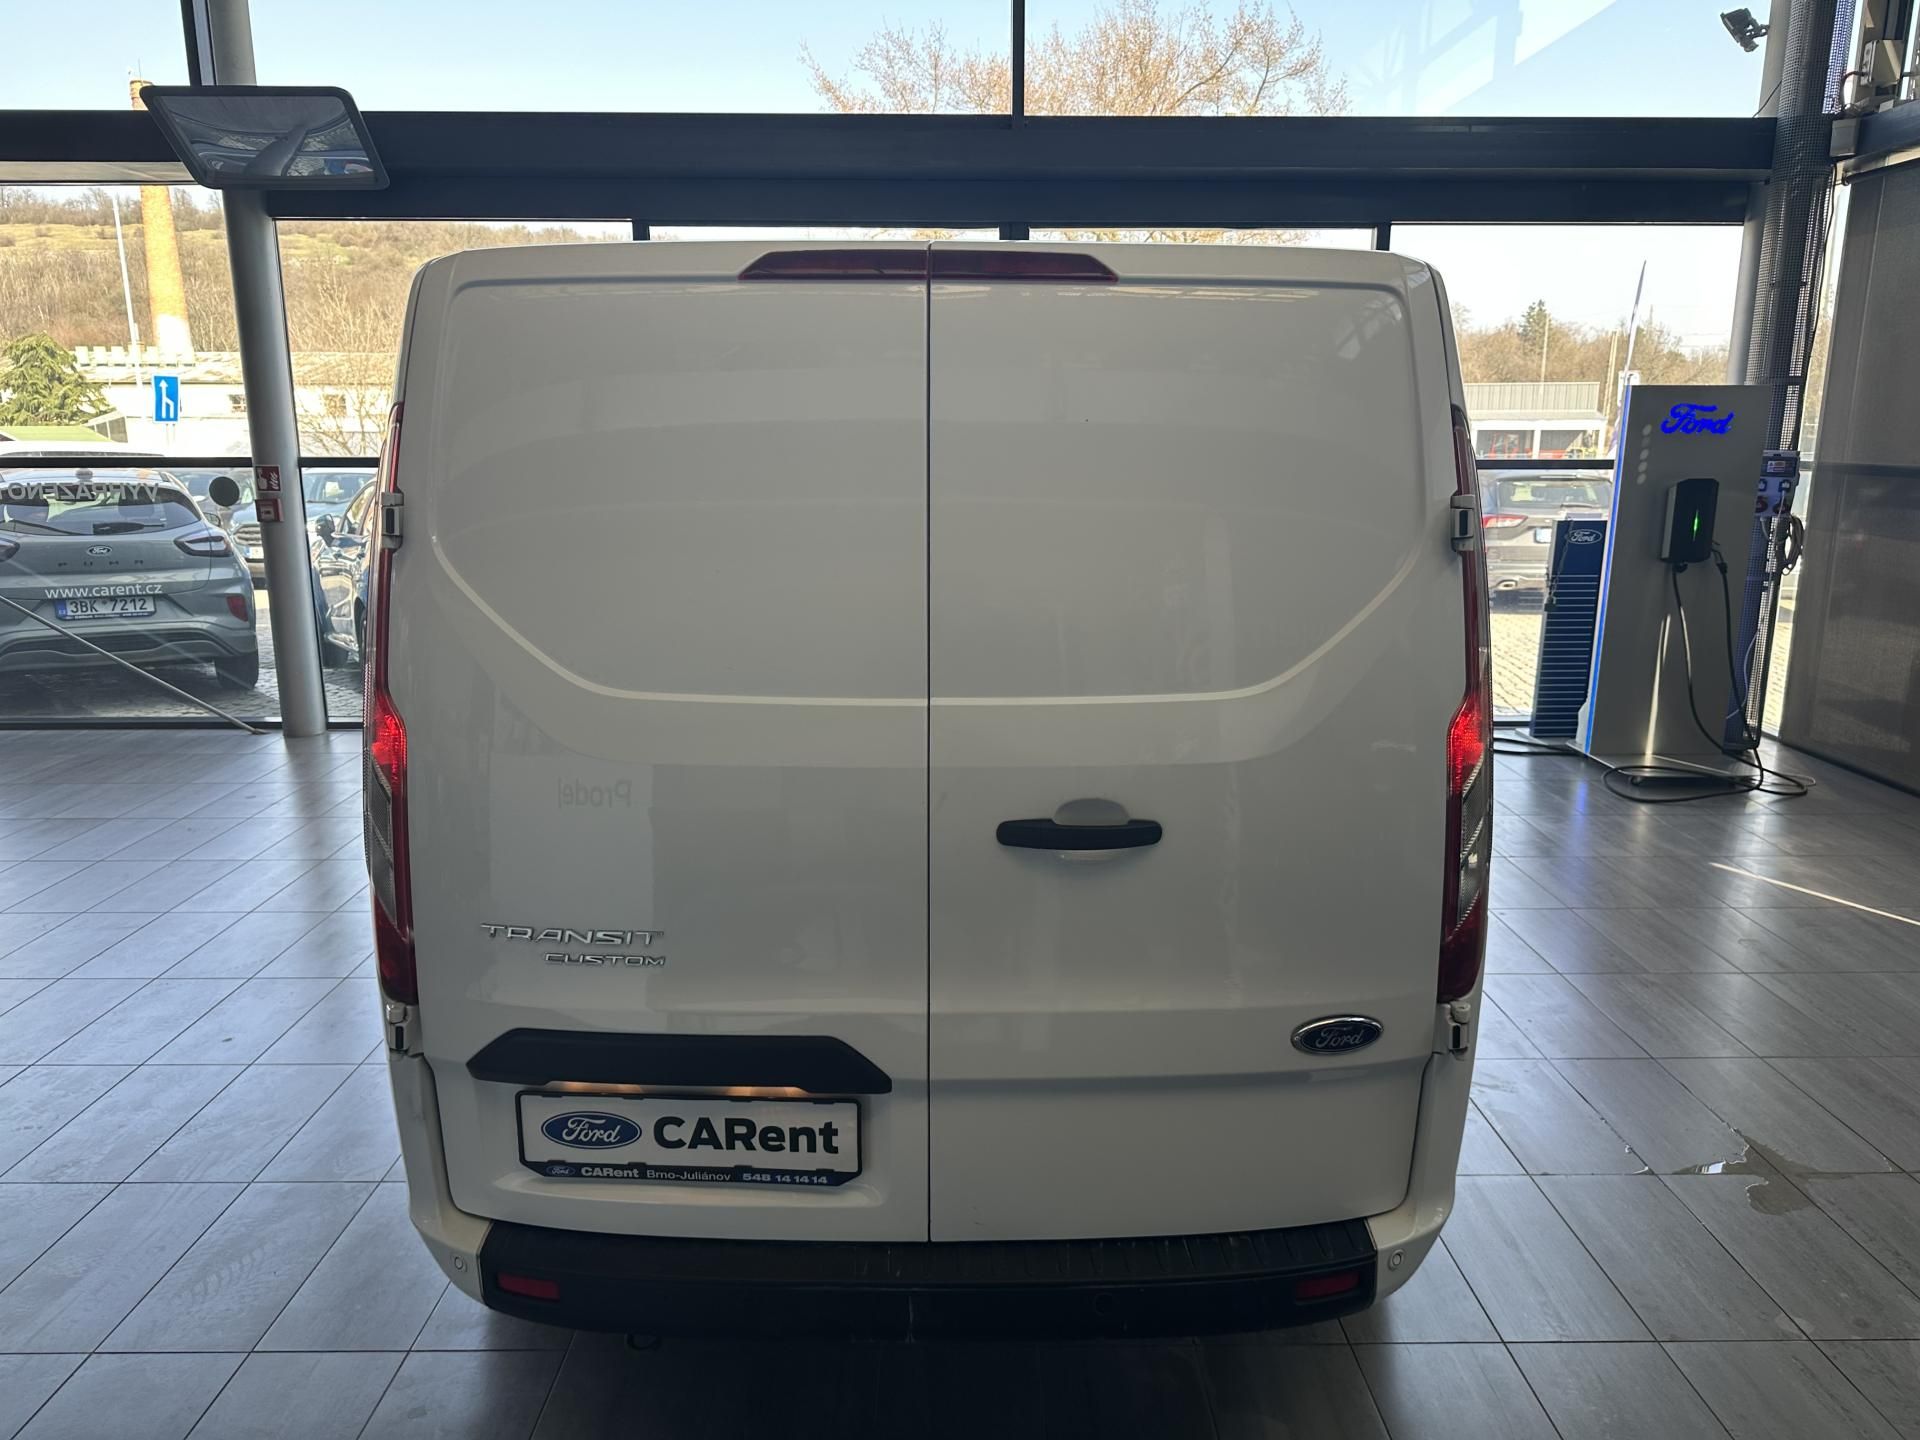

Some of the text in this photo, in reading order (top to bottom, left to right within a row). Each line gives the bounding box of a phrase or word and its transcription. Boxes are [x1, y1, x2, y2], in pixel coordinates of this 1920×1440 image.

[1660, 403, 1734, 434] Ford
[45, 583, 163, 599] www.carent.cz
[69, 601, 98, 614] 3BK
[112, 598, 147, 611] 7212
[480, 923, 664, 946] TRANSIT
[545, 952, 666, 966] CUSTOM
[1315, 1026, 1365, 1048] Ford
[562, 1116, 839, 1154] Ford CARent
[581, 1167, 639, 1178] CARent
[646, 1169, 731, 1182] Brno-Juliánov
[742, 1173, 772, 1182] 548
